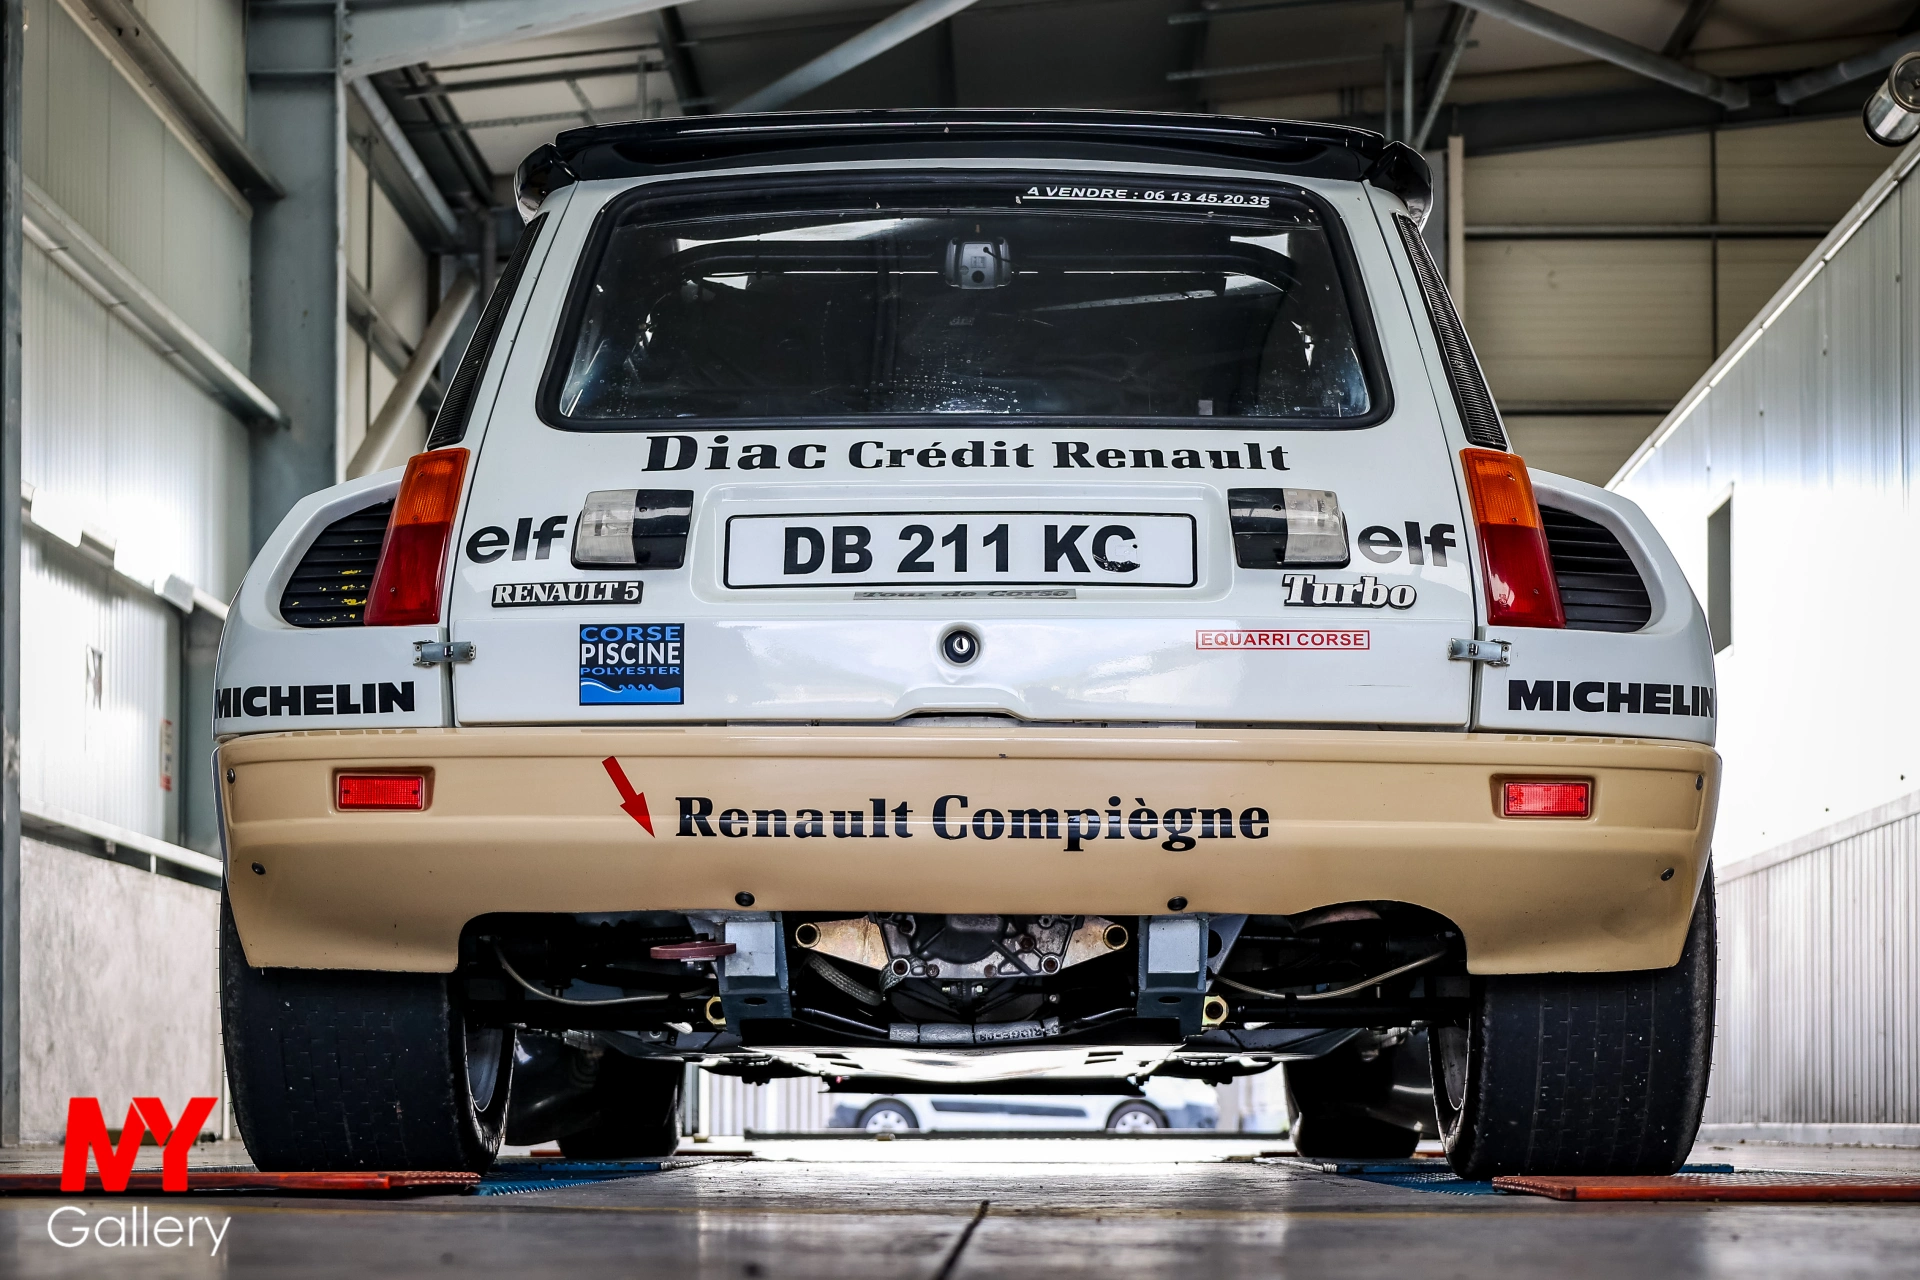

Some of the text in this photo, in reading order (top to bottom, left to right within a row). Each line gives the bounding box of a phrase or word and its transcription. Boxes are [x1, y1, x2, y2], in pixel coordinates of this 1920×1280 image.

[1027, 186, 1040, 196] A
[1045, 186, 1128, 200] VENDRE
[1143, 190, 1165, 201] 06
[1170, 192, 1191, 202] 13
[1196, 193, 1270, 206] 45.20.35
[641, 434, 1291, 471] Diac Crédit Renault
[466, 515, 569, 564] elf
[783, 524, 1141, 575] DB 211 KC
[1357, 520, 1457, 567] elf
[493, 582, 640, 604] RENAULT 5
[1283, 573, 1417, 610] Turbo
[581, 626, 681, 642] CORSE
[1201, 633, 1364, 646] EQUARRI CORSE
[580, 666, 681, 676] POLYESTER
[581, 642, 681, 665] PISCINE
[215, 681, 415, 719] MICHELIN
[1508, 680, 1713, 718] MICHELIN
[675, 795, 1270, 852] Renault Compiègne
